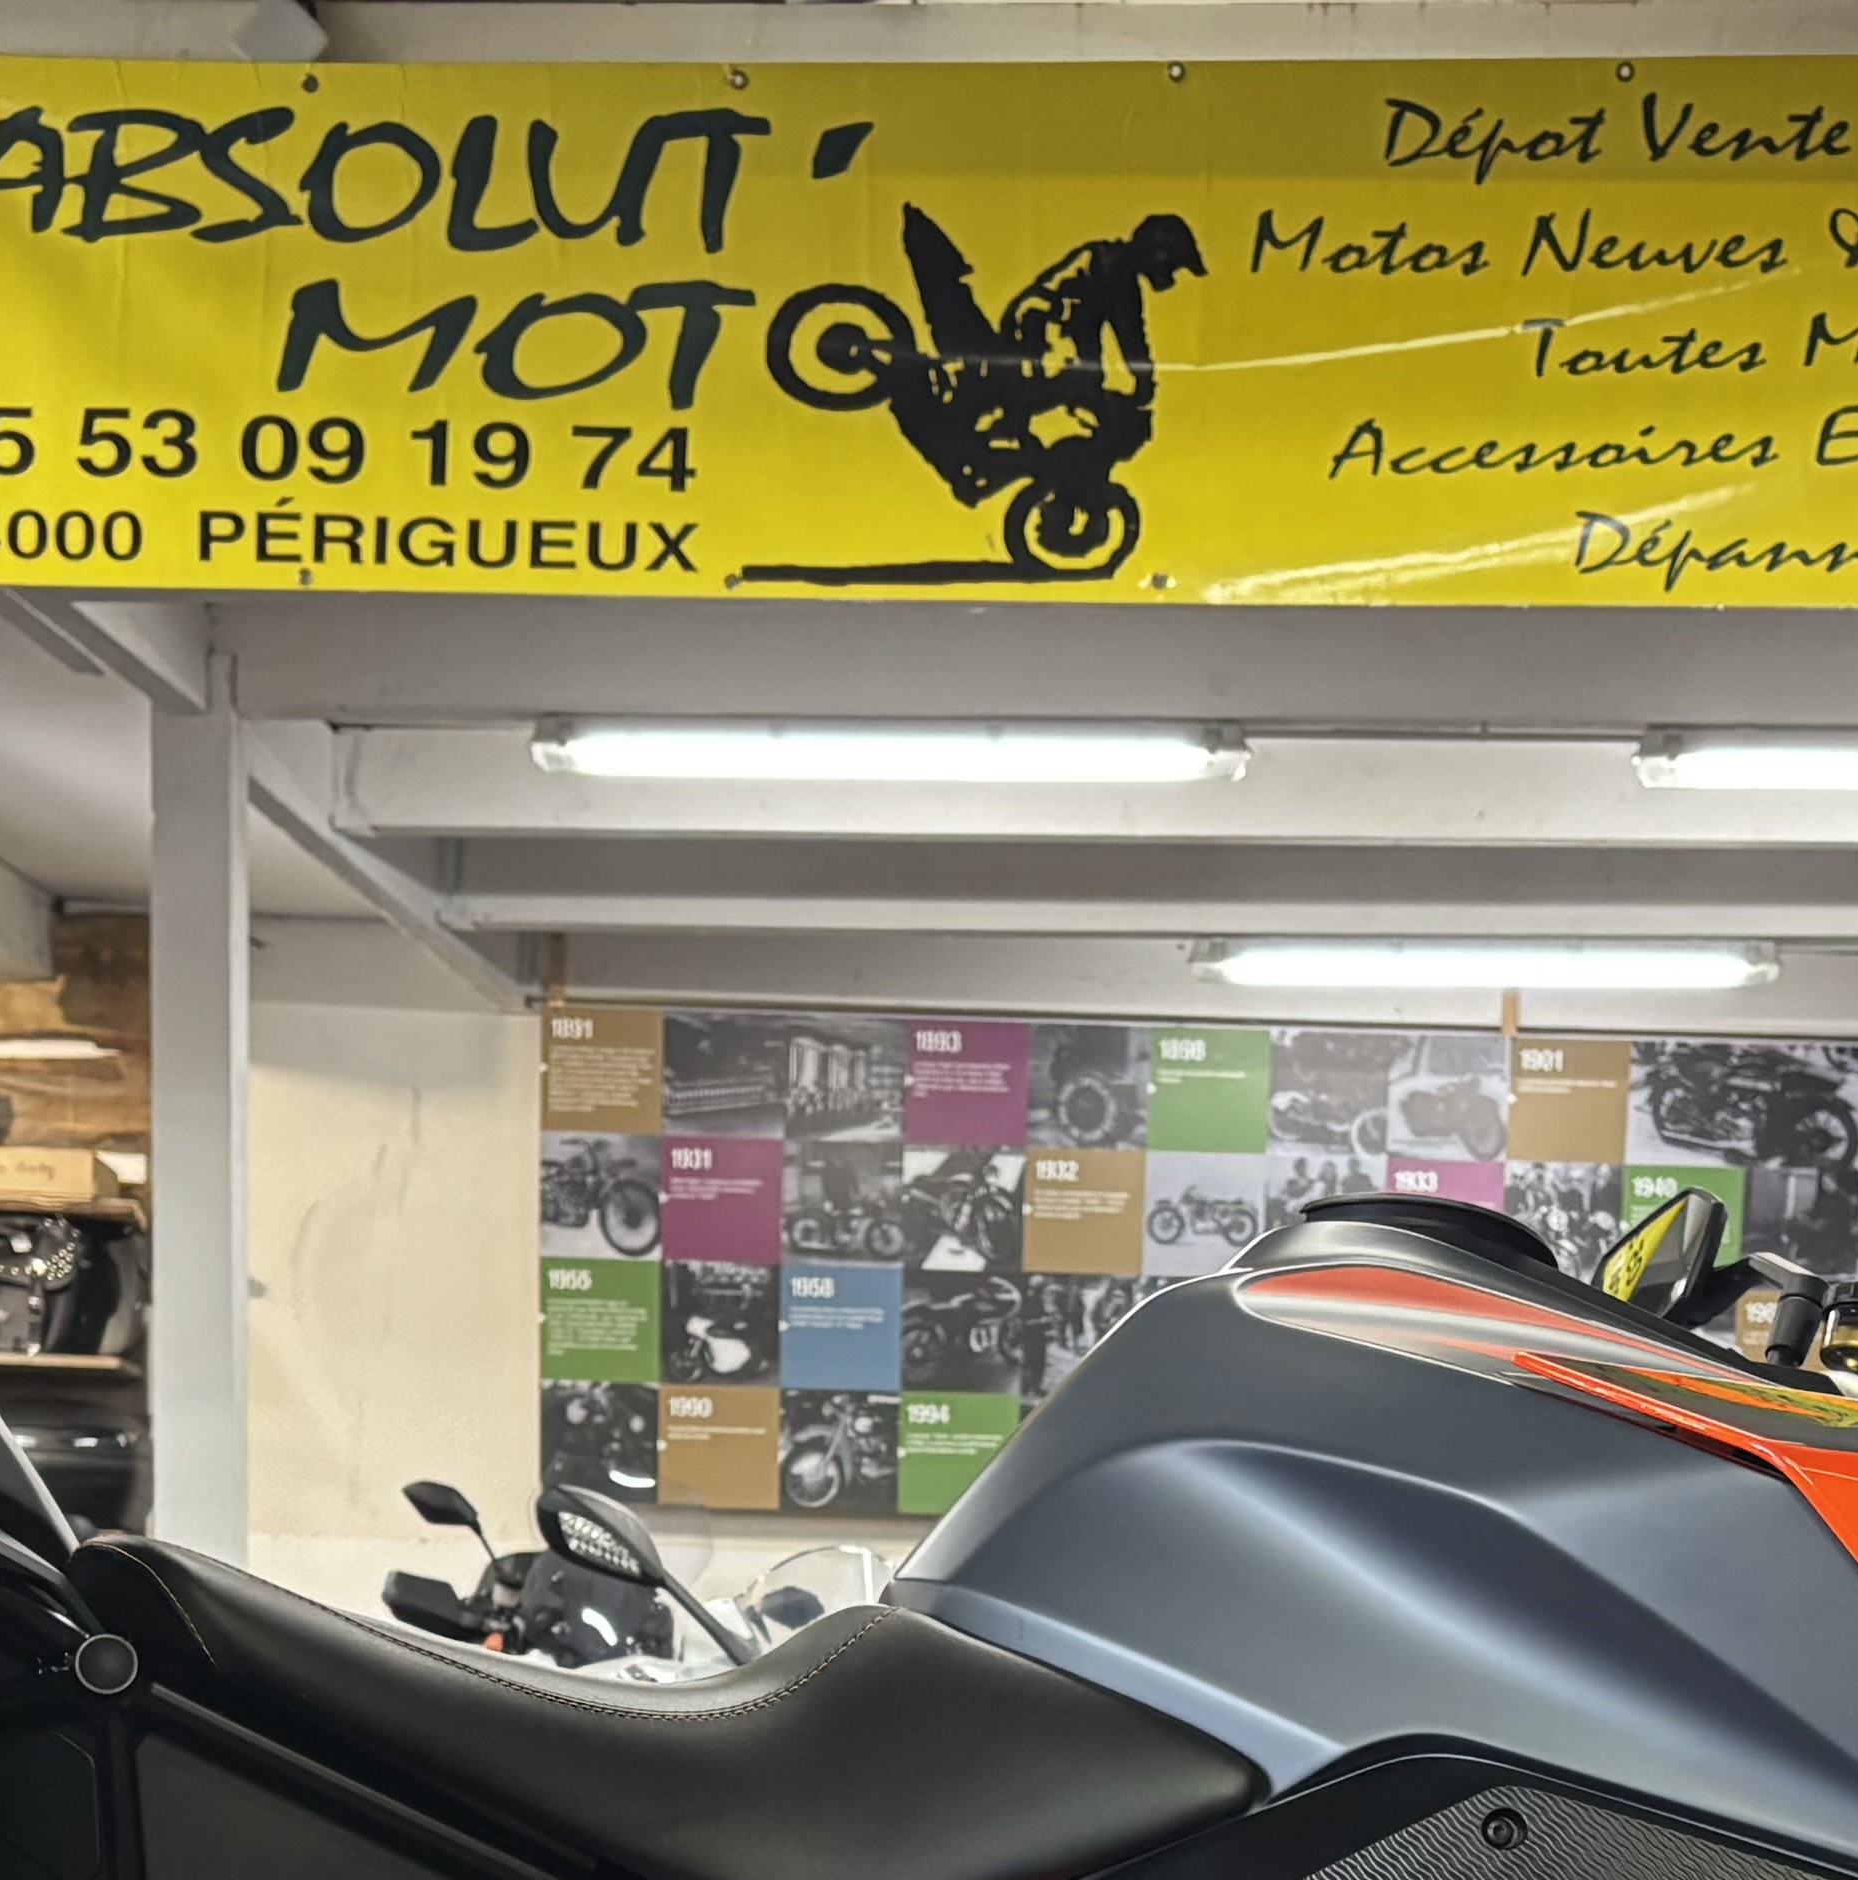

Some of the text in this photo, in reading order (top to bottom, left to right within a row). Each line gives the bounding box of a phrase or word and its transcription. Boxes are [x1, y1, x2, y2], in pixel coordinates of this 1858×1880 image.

[1384, 98, 1606, 185] Dépot
[1641, 91, 1852, 163] Vente
[1251, 209, 1489, 276] Motos
[1522, 208, 1788, 276] Neuves
[1520, 317, 1765, 378] Toutes
[78, 409, 196, 477] 53
[242, 416, 364, 483] 09
[412, 420, 529, 488] 19
[573, 426, 695, 491] 74
[1330, 419, 1772, 478] Accessoires
[201, 498, 695, 571] PÉRIGUEUX
